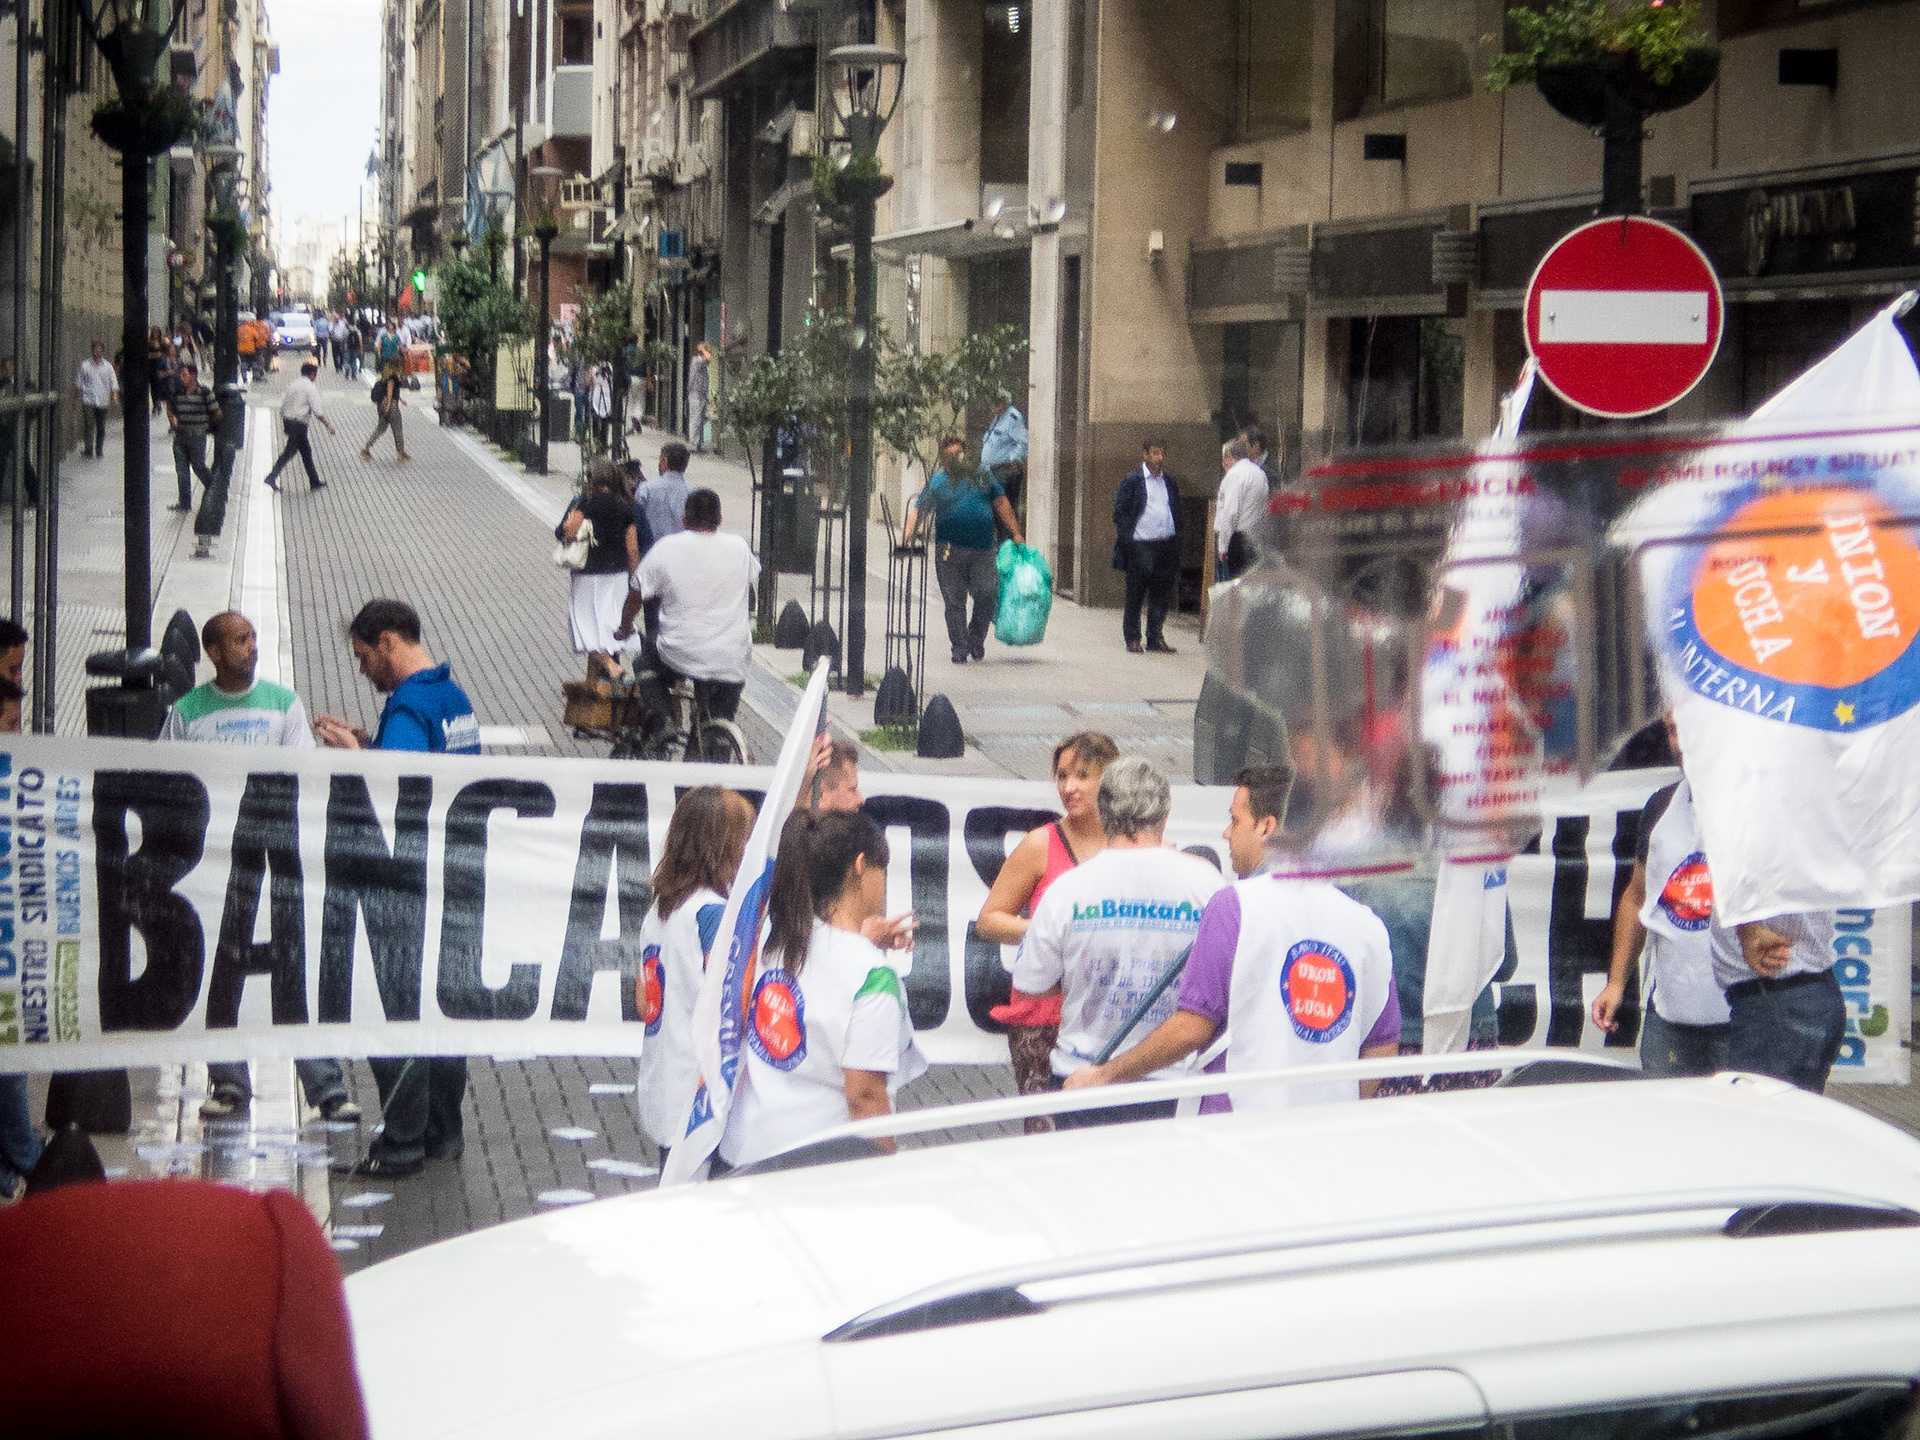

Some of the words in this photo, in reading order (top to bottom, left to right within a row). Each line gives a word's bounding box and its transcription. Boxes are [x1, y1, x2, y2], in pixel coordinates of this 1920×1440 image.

[1727, 562, 1793, 665] UCHA
[1680, 640, 1796, 722] INTERNA
[17, 766, 46, 923] SINDICATO
[54, 775, 80, 841] AIRES
[55, 849, 80, 935] BUENOS
[22, 939, 50, 1043] NUESTRO
